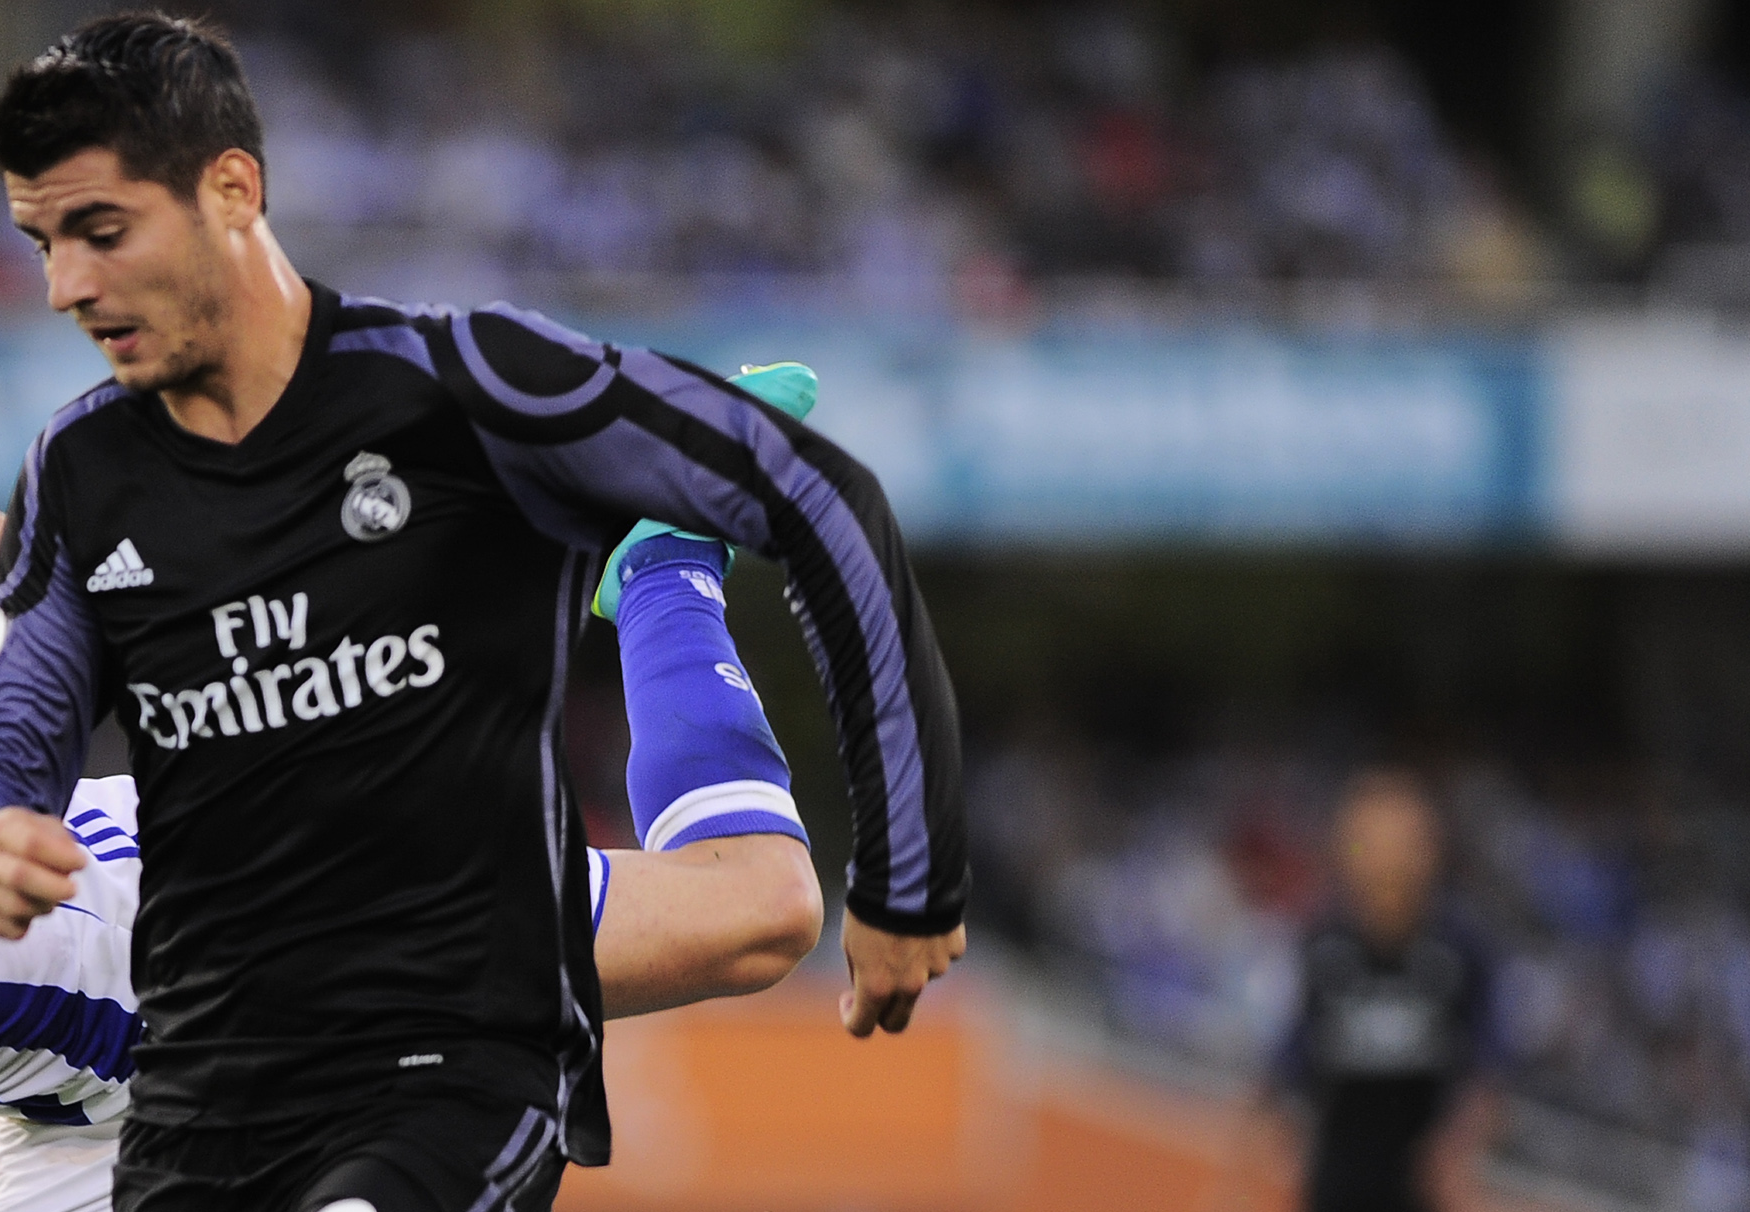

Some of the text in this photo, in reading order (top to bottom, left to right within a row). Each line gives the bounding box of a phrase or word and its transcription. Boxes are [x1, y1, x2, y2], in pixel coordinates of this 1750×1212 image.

[86, 567, 155, 593] adidas
[211, 591, 309, 658] Fly
[126, 623, 446, 750] Emirates
